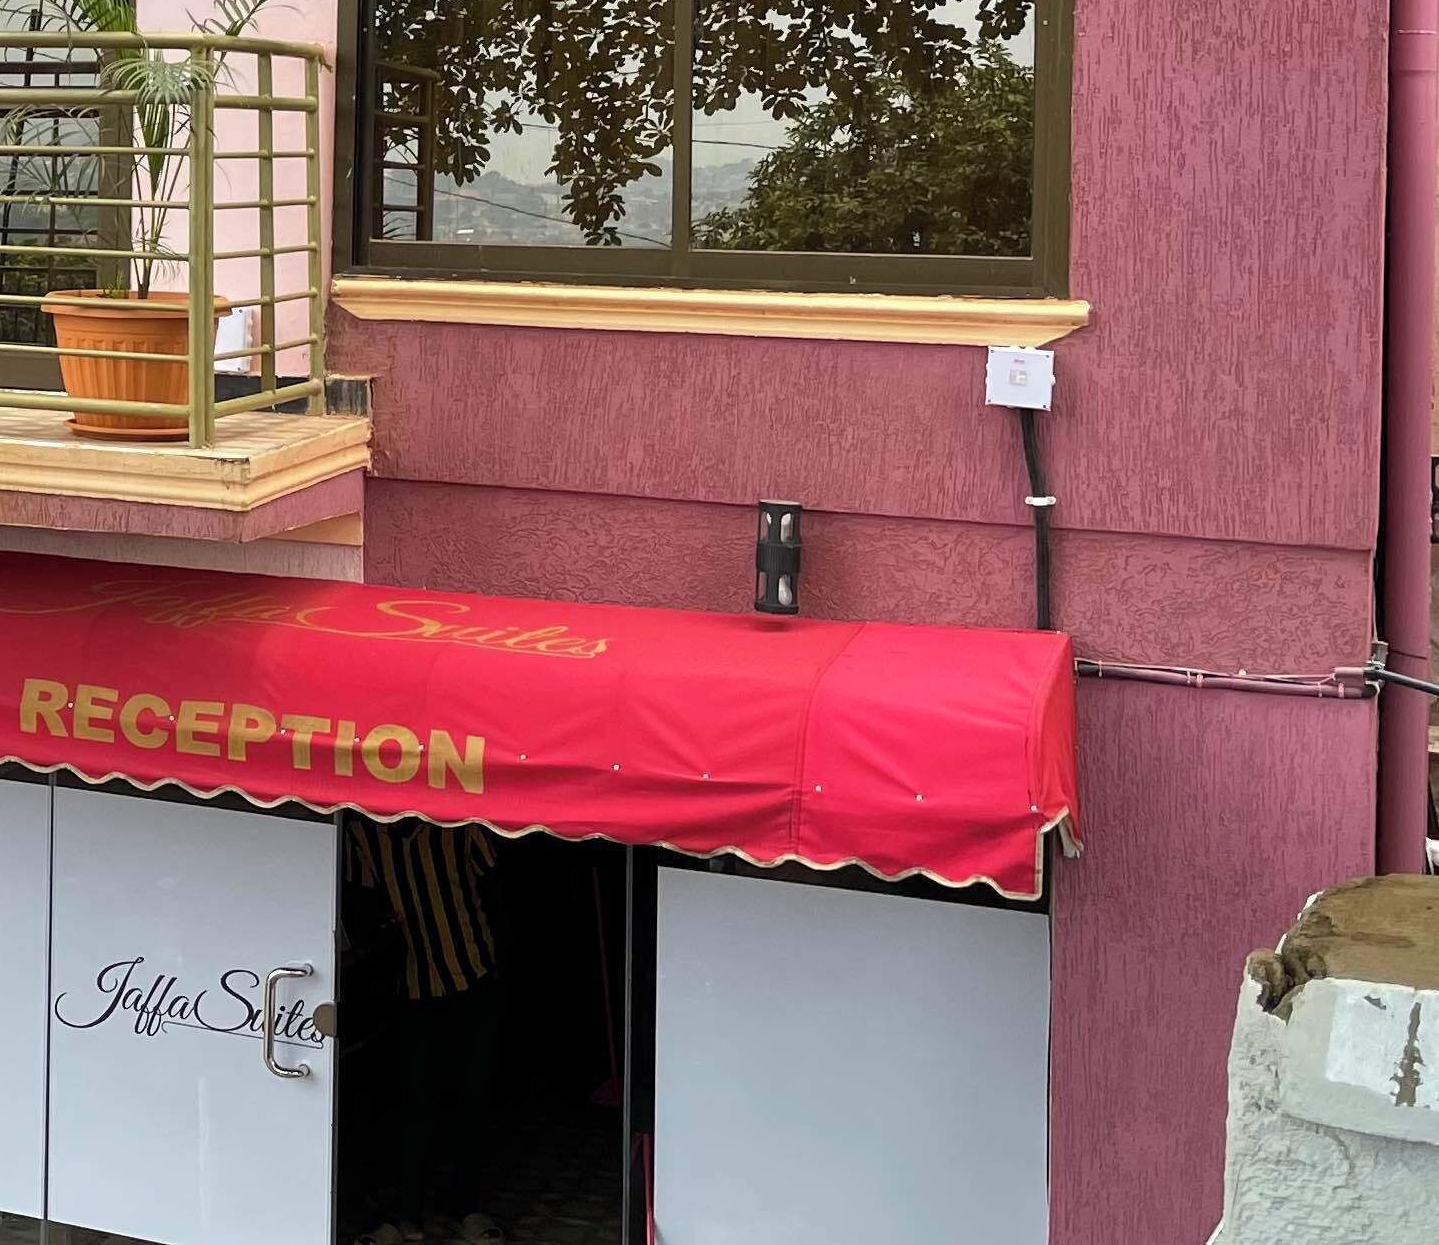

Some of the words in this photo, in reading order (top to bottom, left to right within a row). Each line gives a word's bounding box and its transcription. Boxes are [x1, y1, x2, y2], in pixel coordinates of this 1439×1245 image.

[295, 599, 610, 658] Suites
[18, 677, 487, 794] RECEPTION
[55, 956, 190, 1037] Jaffa
